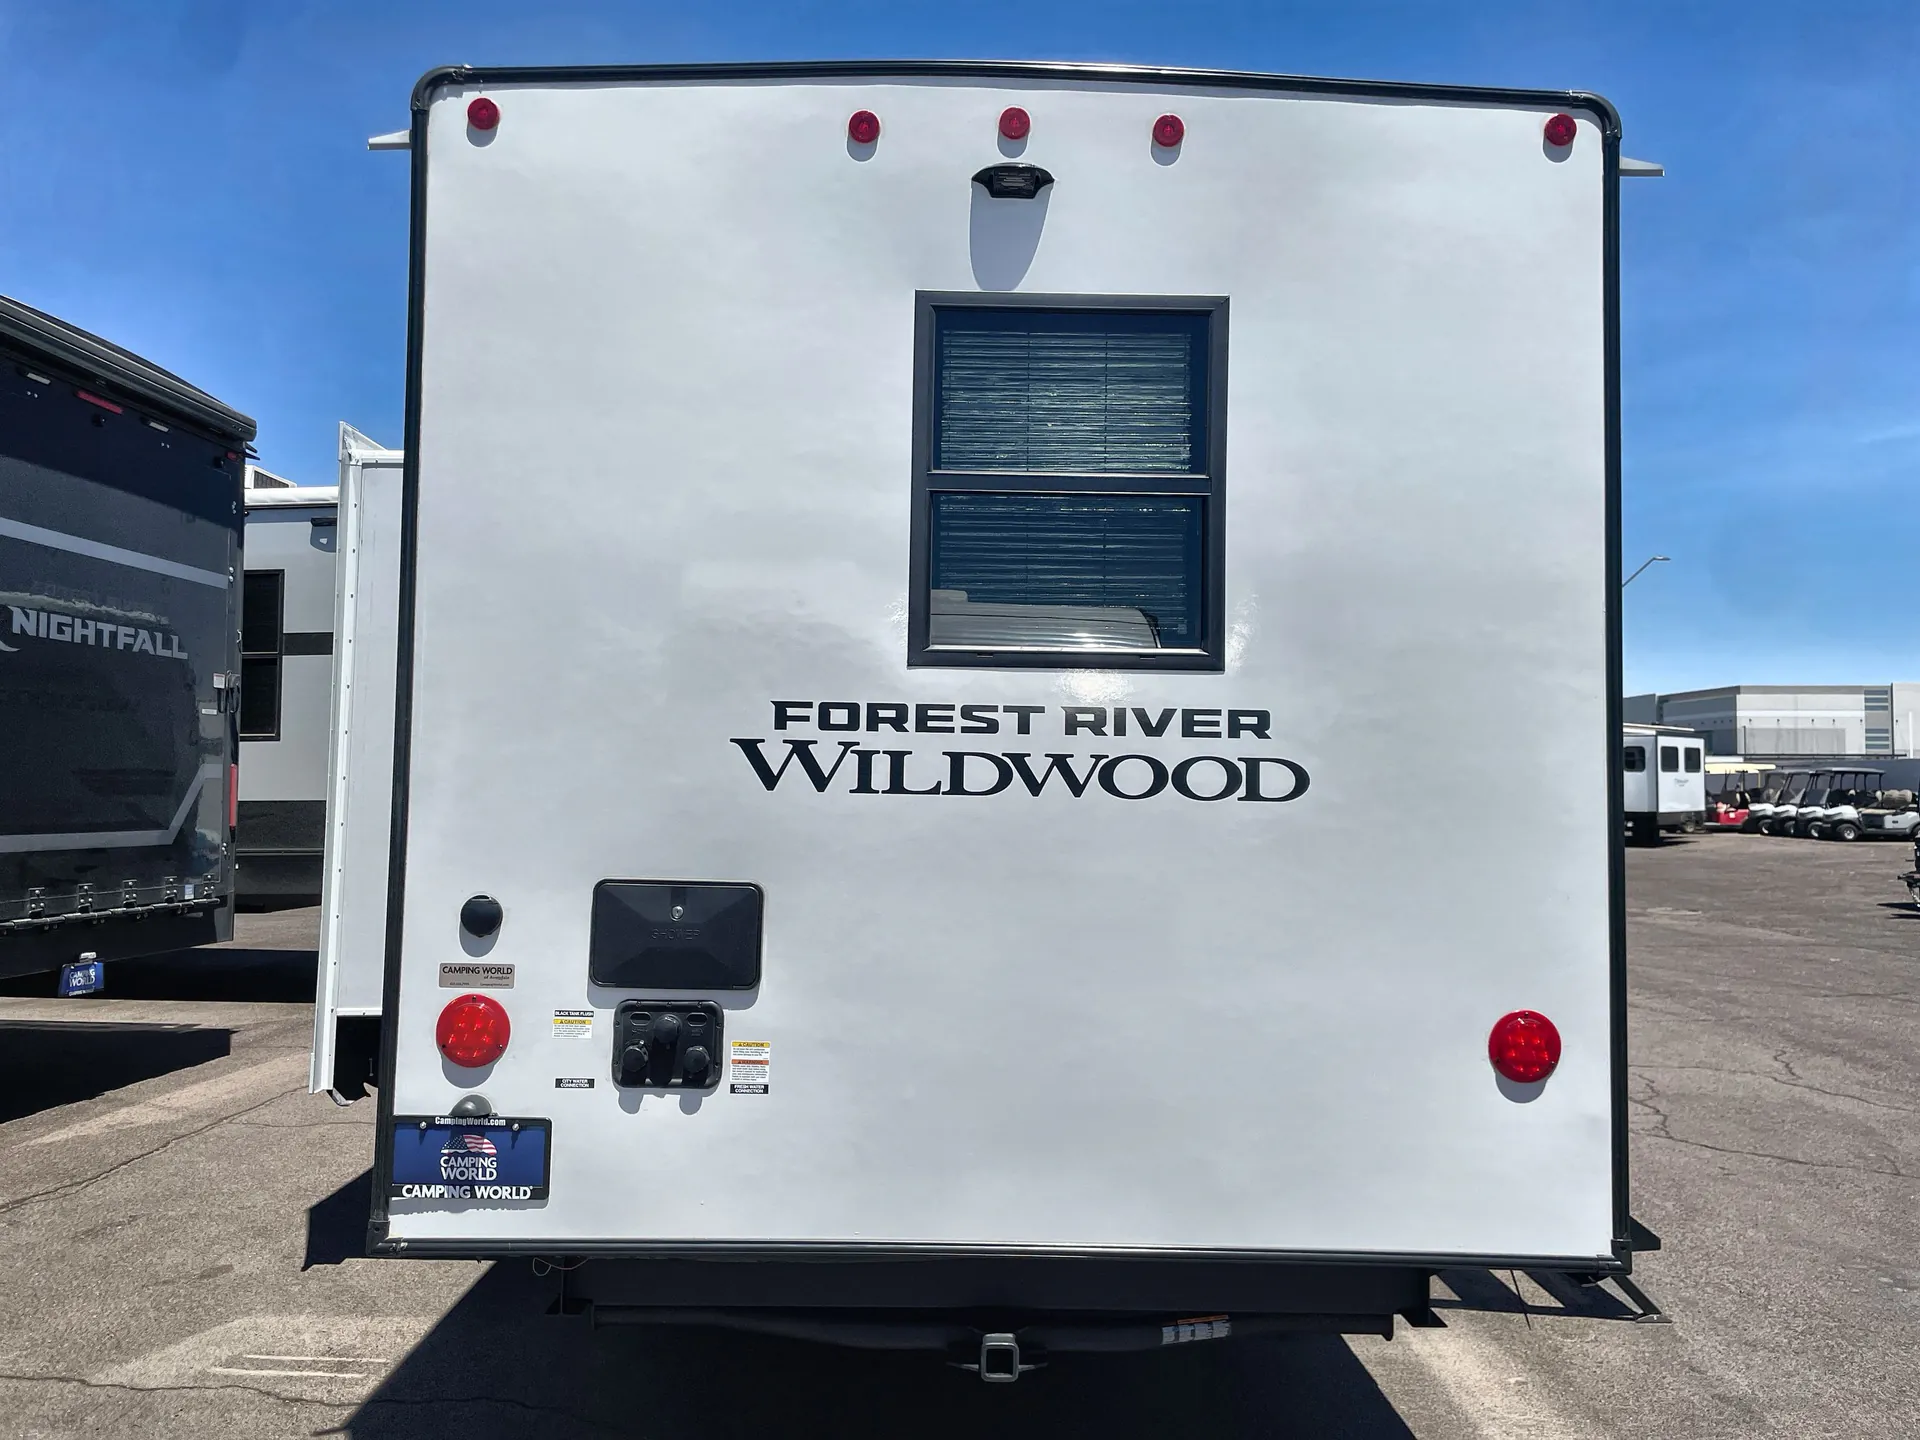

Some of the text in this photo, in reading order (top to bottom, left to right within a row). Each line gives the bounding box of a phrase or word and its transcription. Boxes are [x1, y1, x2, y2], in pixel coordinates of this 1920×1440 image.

[8, 605, 189, 660] NIGHTFALL
[770, 700, 1272, 739] FOREST RIVER
[729, 737, 1311, 803] WILDWOOD
[442, 966, 513, 975] CAMPING WORLD
[69, 976, 96, 987] WORLD
[434, 1116, 506, 1127] CampingWorld.com
[440, 1156, 497, 1168] CAMPING
[440, 1167, 497, 1181] WORLD
[401, 1184, 471, 1199] CAMPING
